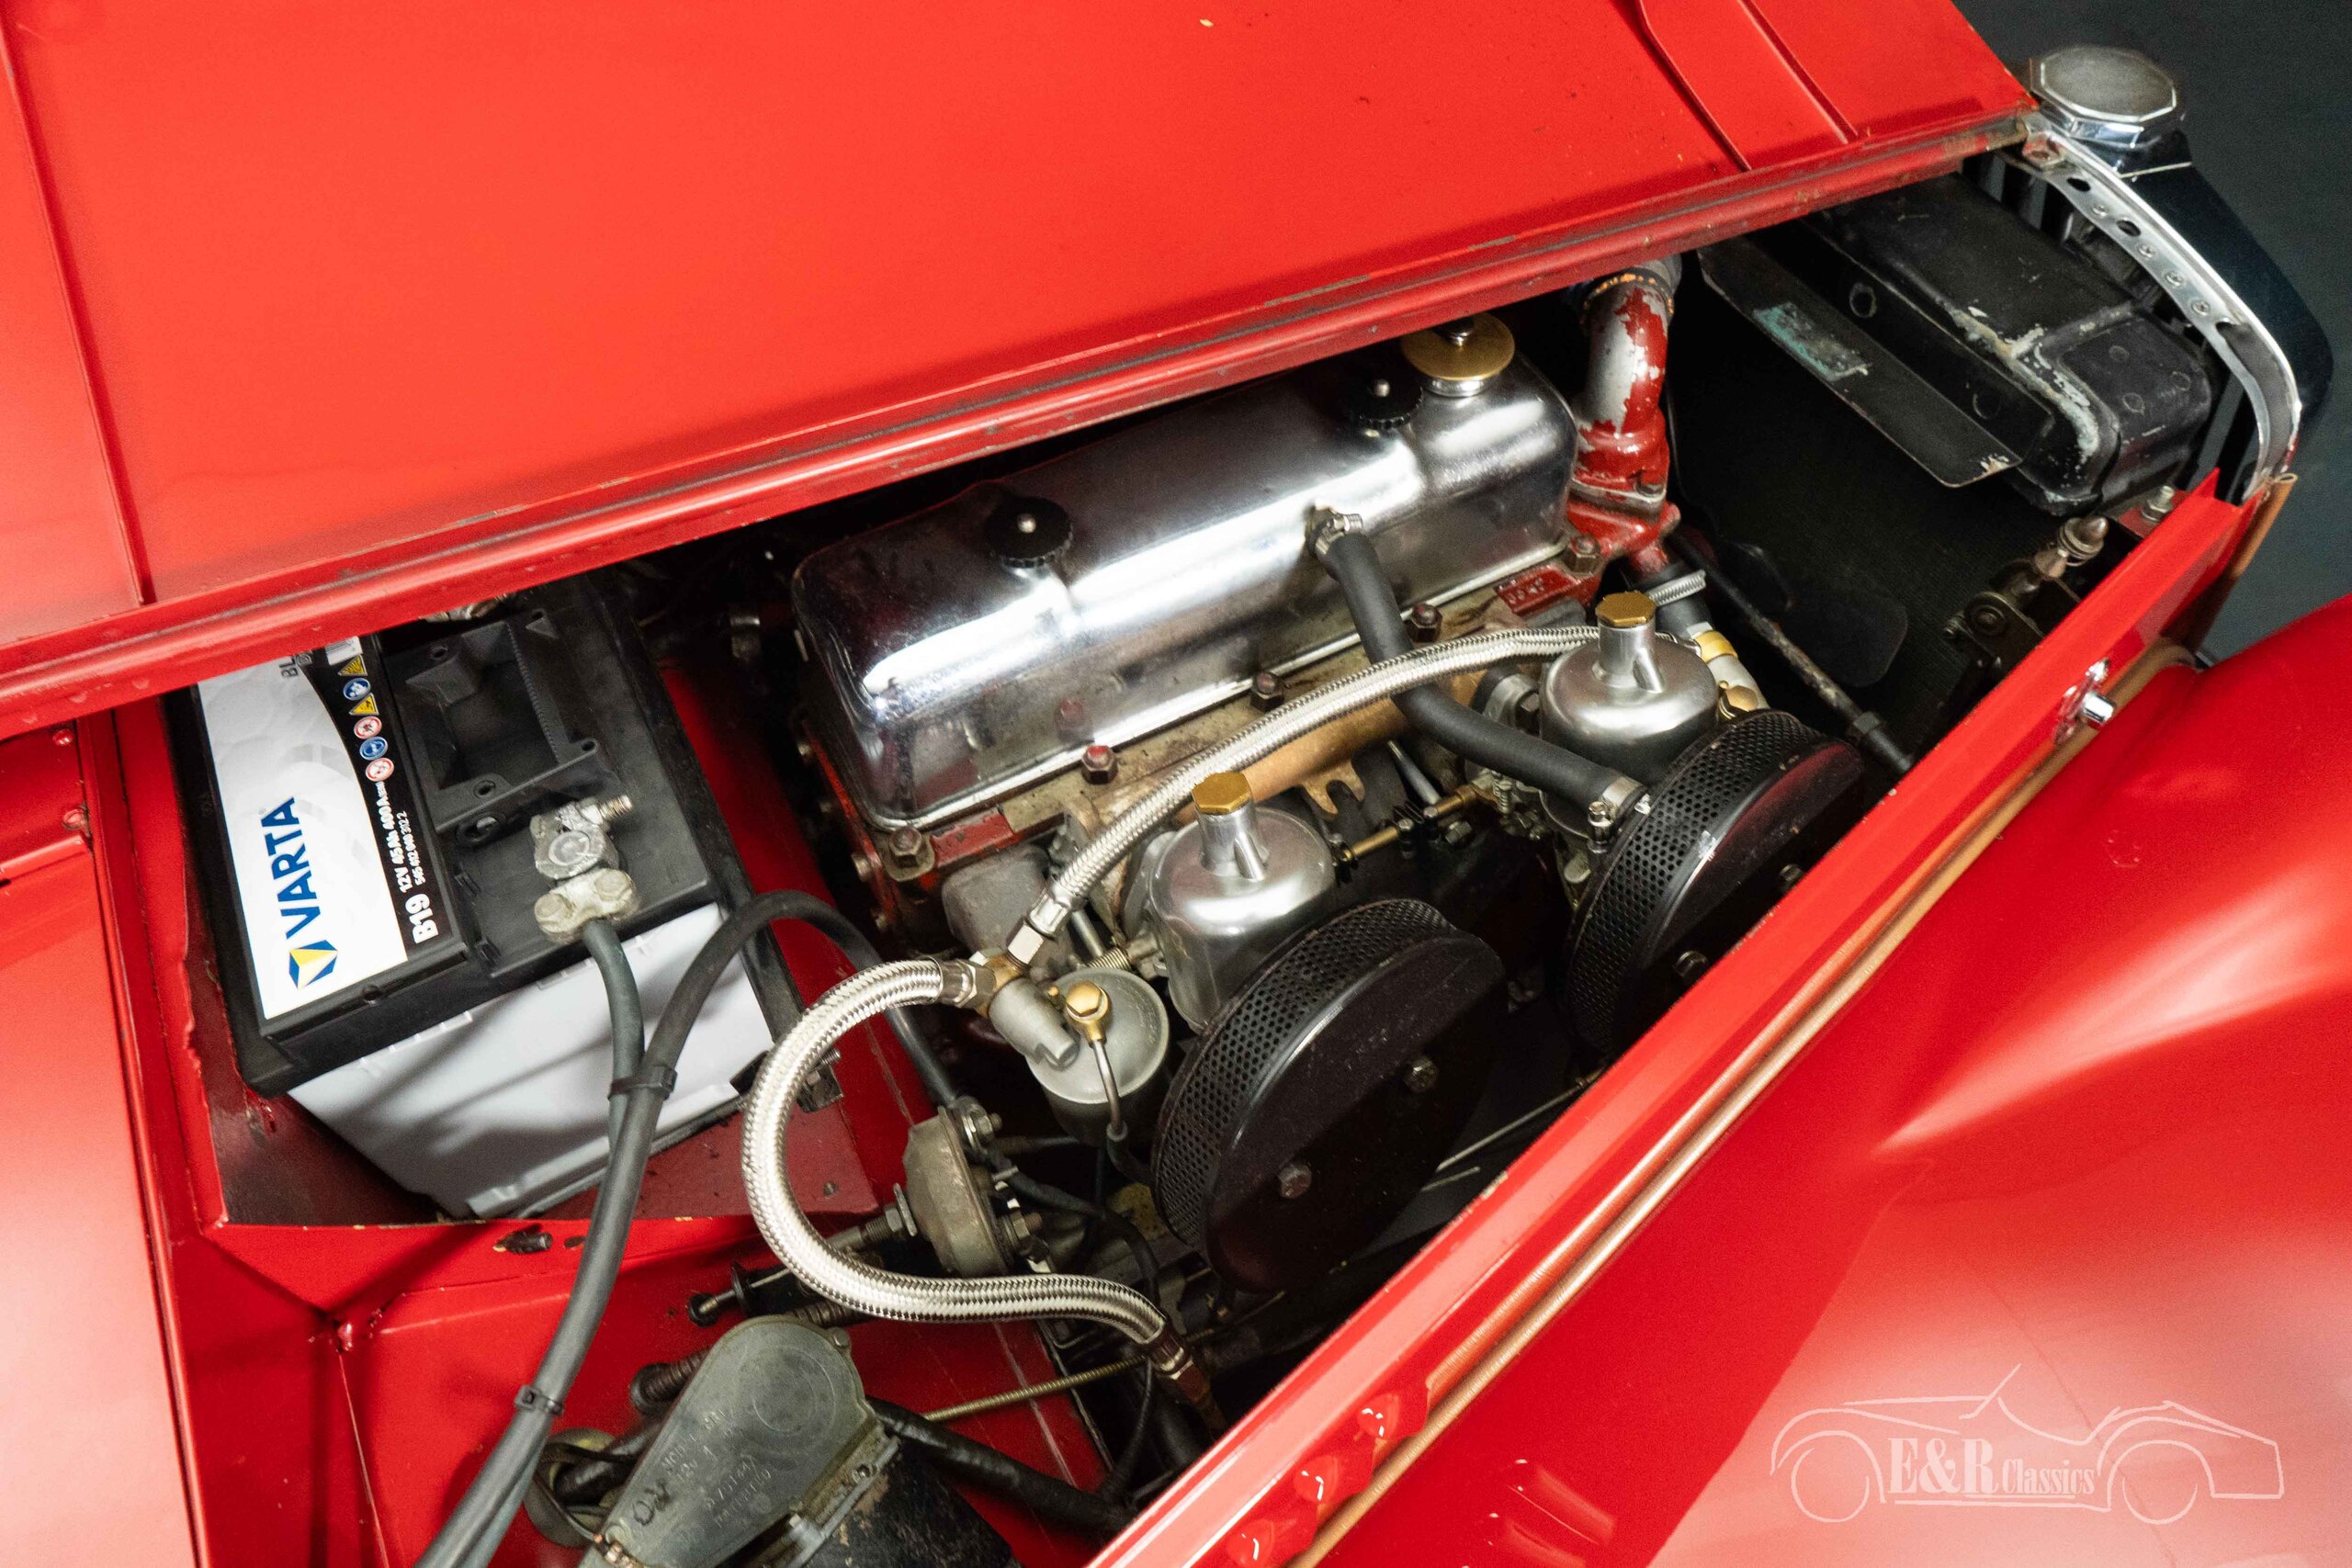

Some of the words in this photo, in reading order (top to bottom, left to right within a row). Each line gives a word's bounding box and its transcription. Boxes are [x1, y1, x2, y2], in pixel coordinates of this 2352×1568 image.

[260, 796, 322, 939] VARTA
[386, 829, 404, 864] 45Ah
[394, 866, 413, 893] 12V
[405, 894, 438, 944] B19
